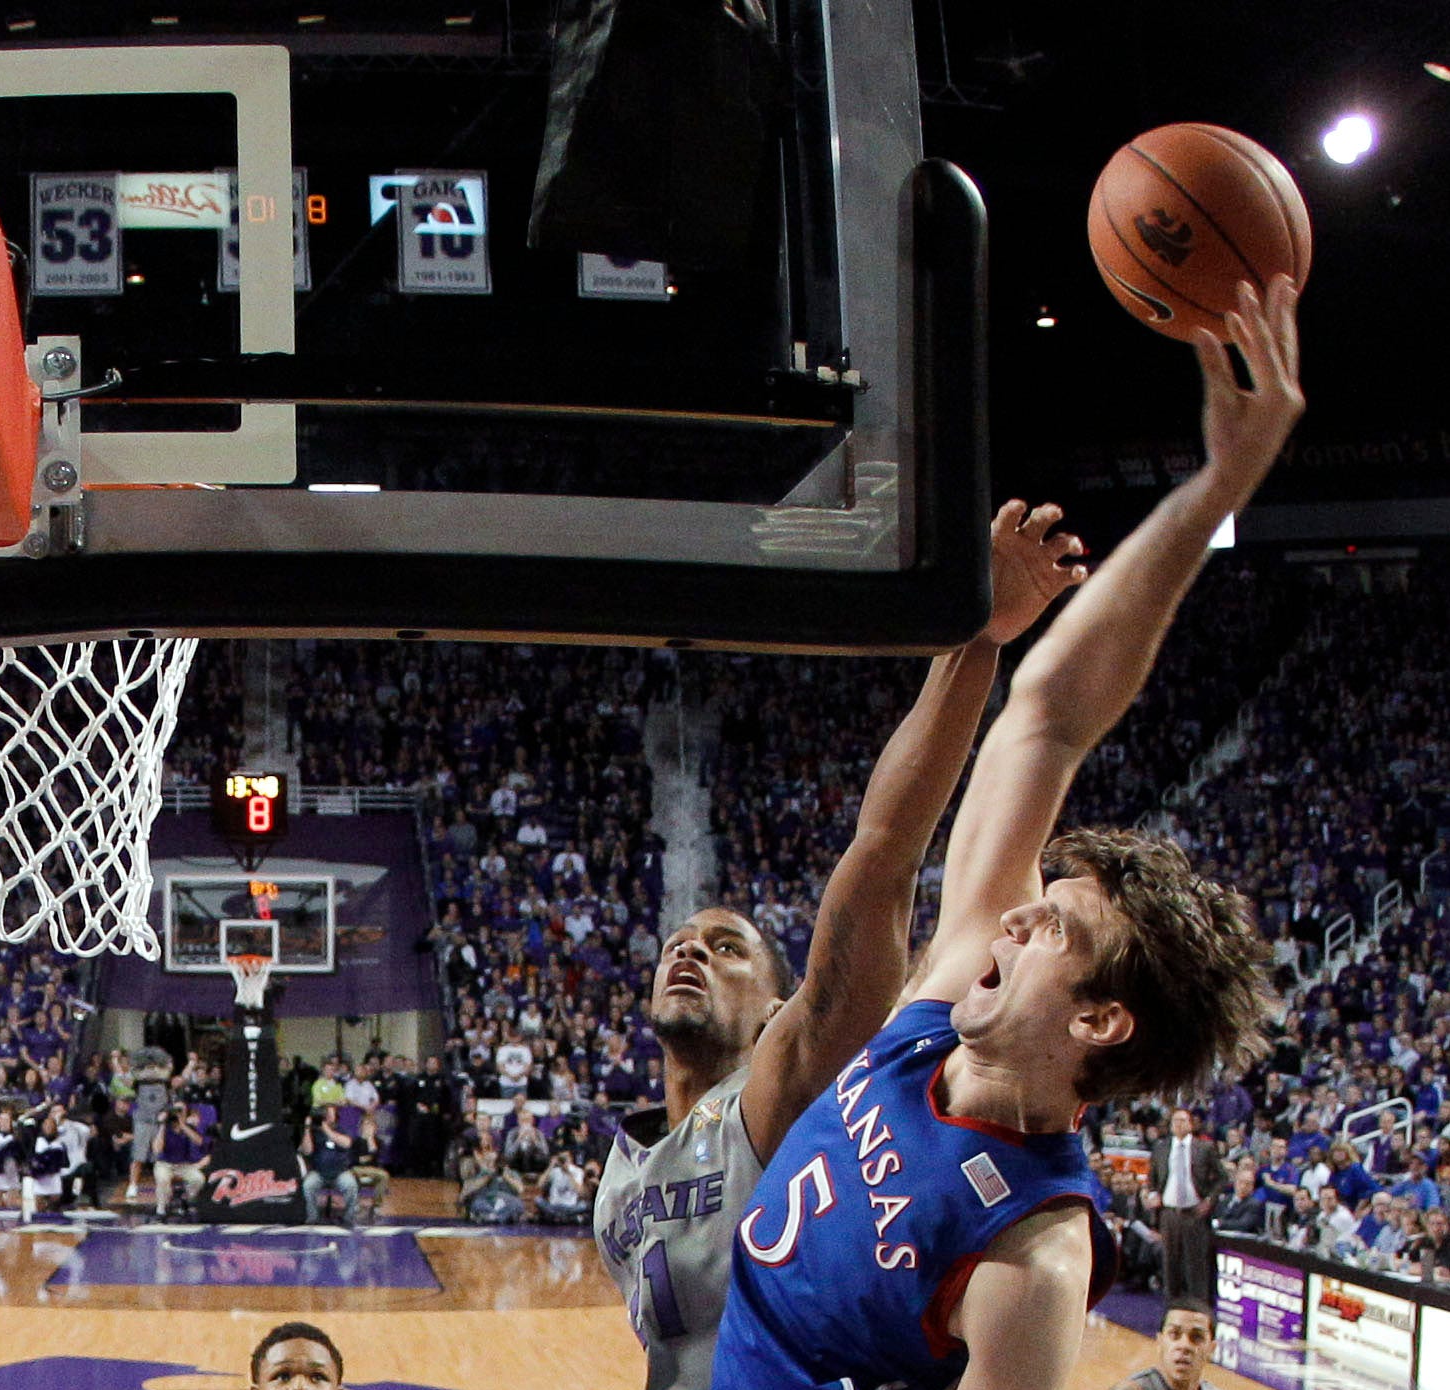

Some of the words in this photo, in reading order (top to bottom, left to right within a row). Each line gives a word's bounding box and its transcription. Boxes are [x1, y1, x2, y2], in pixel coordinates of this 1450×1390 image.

[40, 207, 113, 264] 53
[248, 796, 270, 832] 8
[835, 1047, 919, 1273] KANSAS
[601, 1171, 724, 1267] K-SATE
[738, 1151, 837, 1269] 5
[642, 1239, 688, 1341] 1
